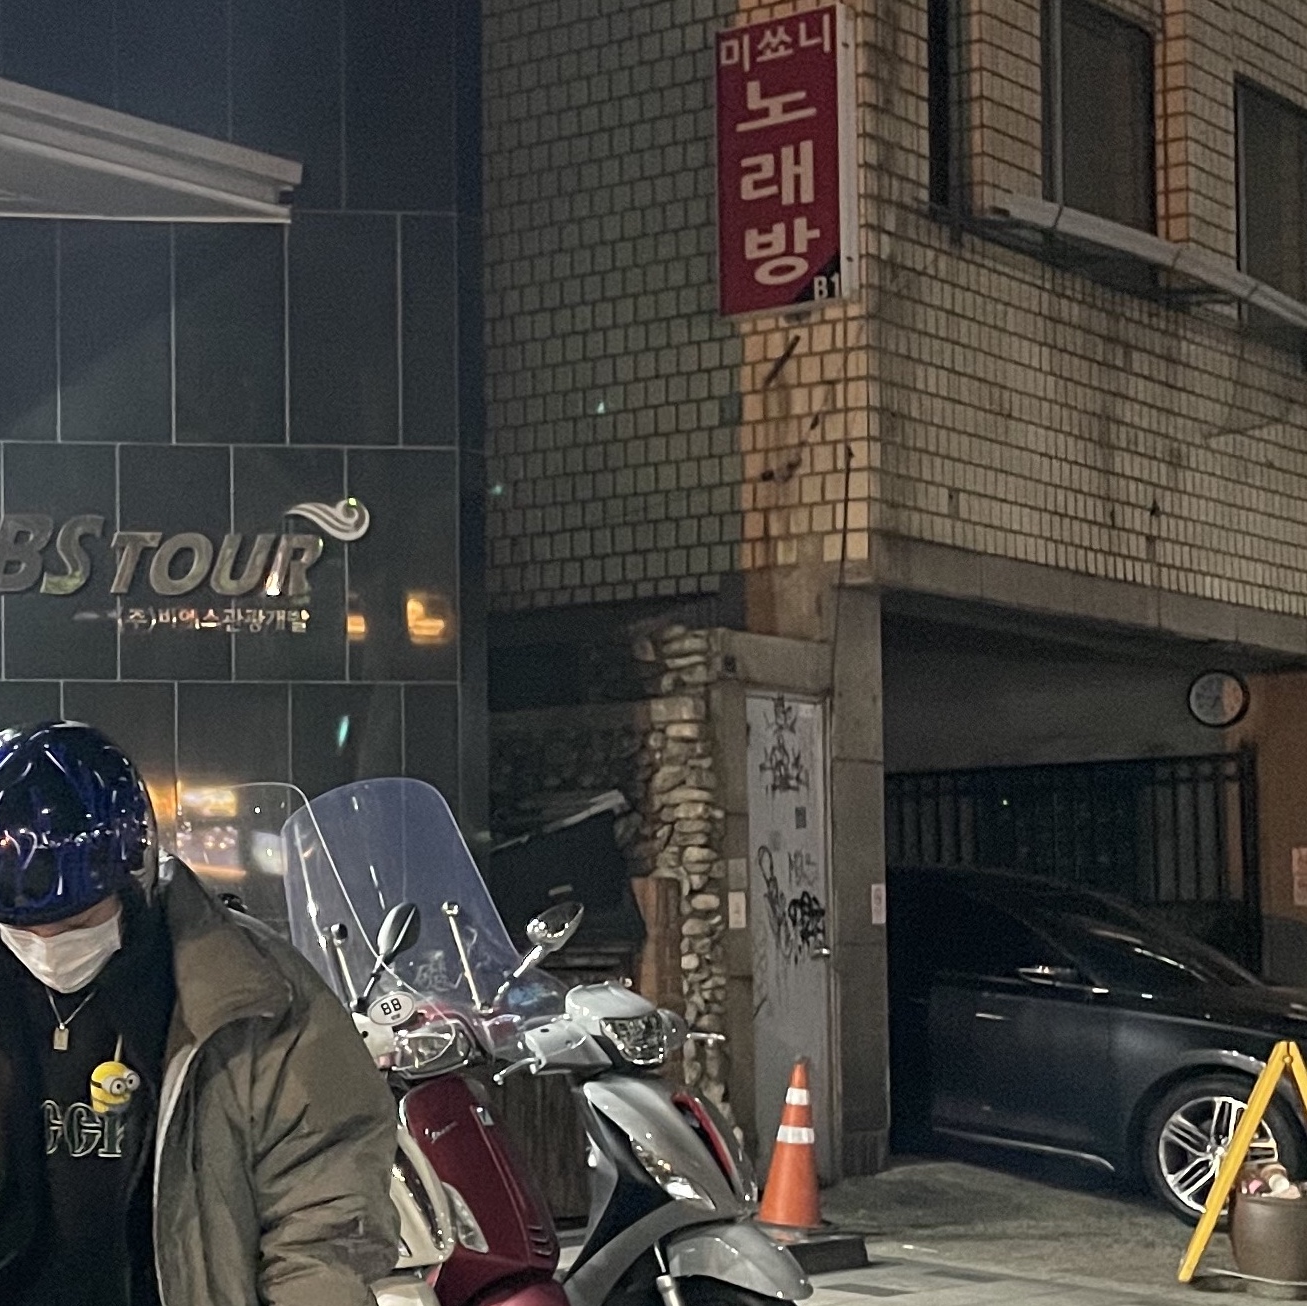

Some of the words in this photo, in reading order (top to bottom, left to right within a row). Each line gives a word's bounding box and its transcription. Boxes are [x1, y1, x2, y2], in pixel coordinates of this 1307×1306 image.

[720, 13, 831, 72] 미쏘니
[735, 79, 821, 286] 노래방
[813, 272, 841, 301] B1
[110, 531, 324, 597] TOUR
